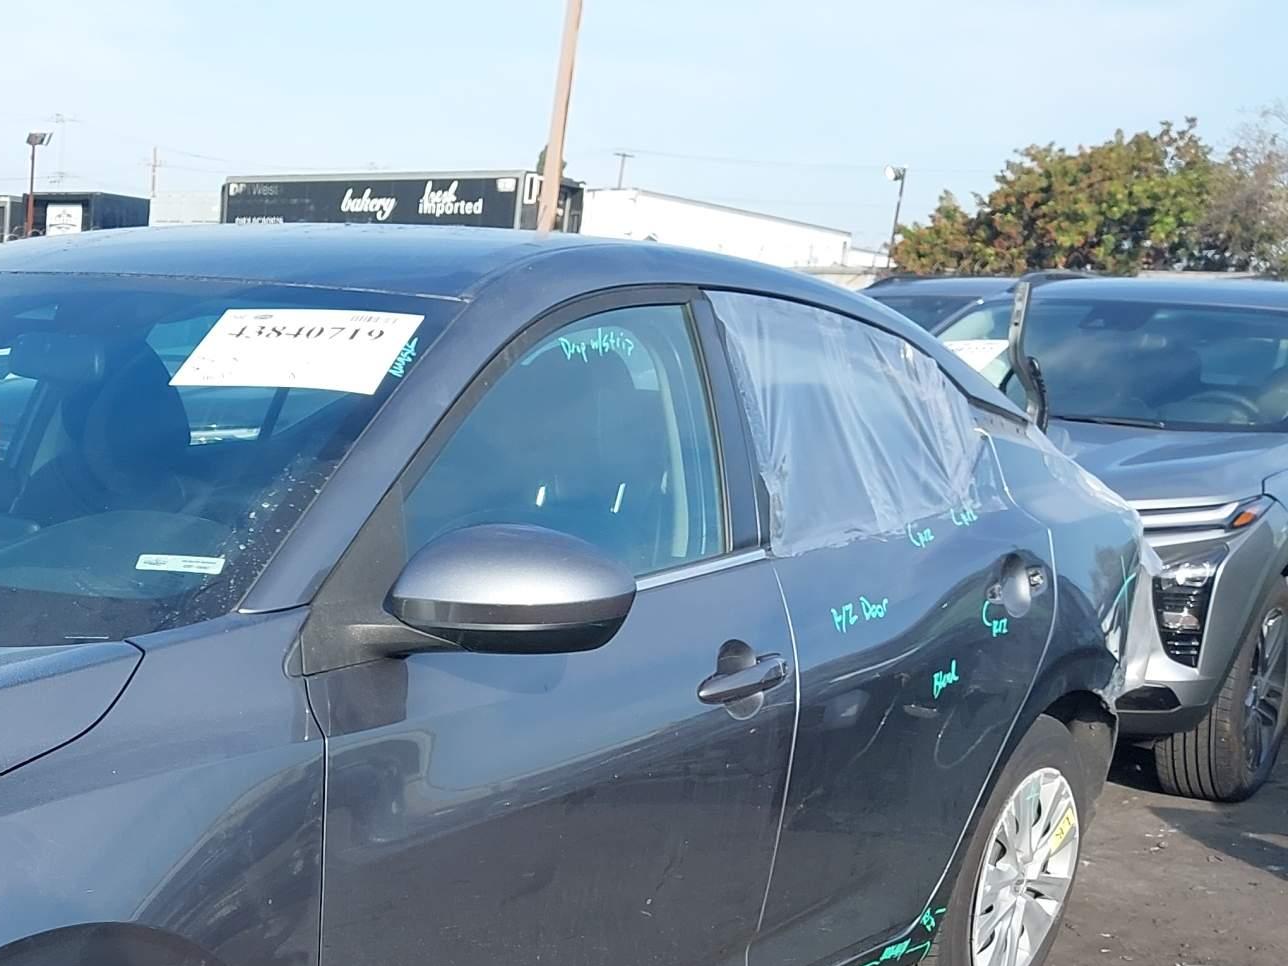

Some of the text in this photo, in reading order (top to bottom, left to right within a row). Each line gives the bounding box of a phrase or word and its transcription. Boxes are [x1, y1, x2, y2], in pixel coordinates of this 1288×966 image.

[340, 188, 397, 221] bakery
[418, 198, 483, 217] imported
[228, 325, 385, 341] 43840719
